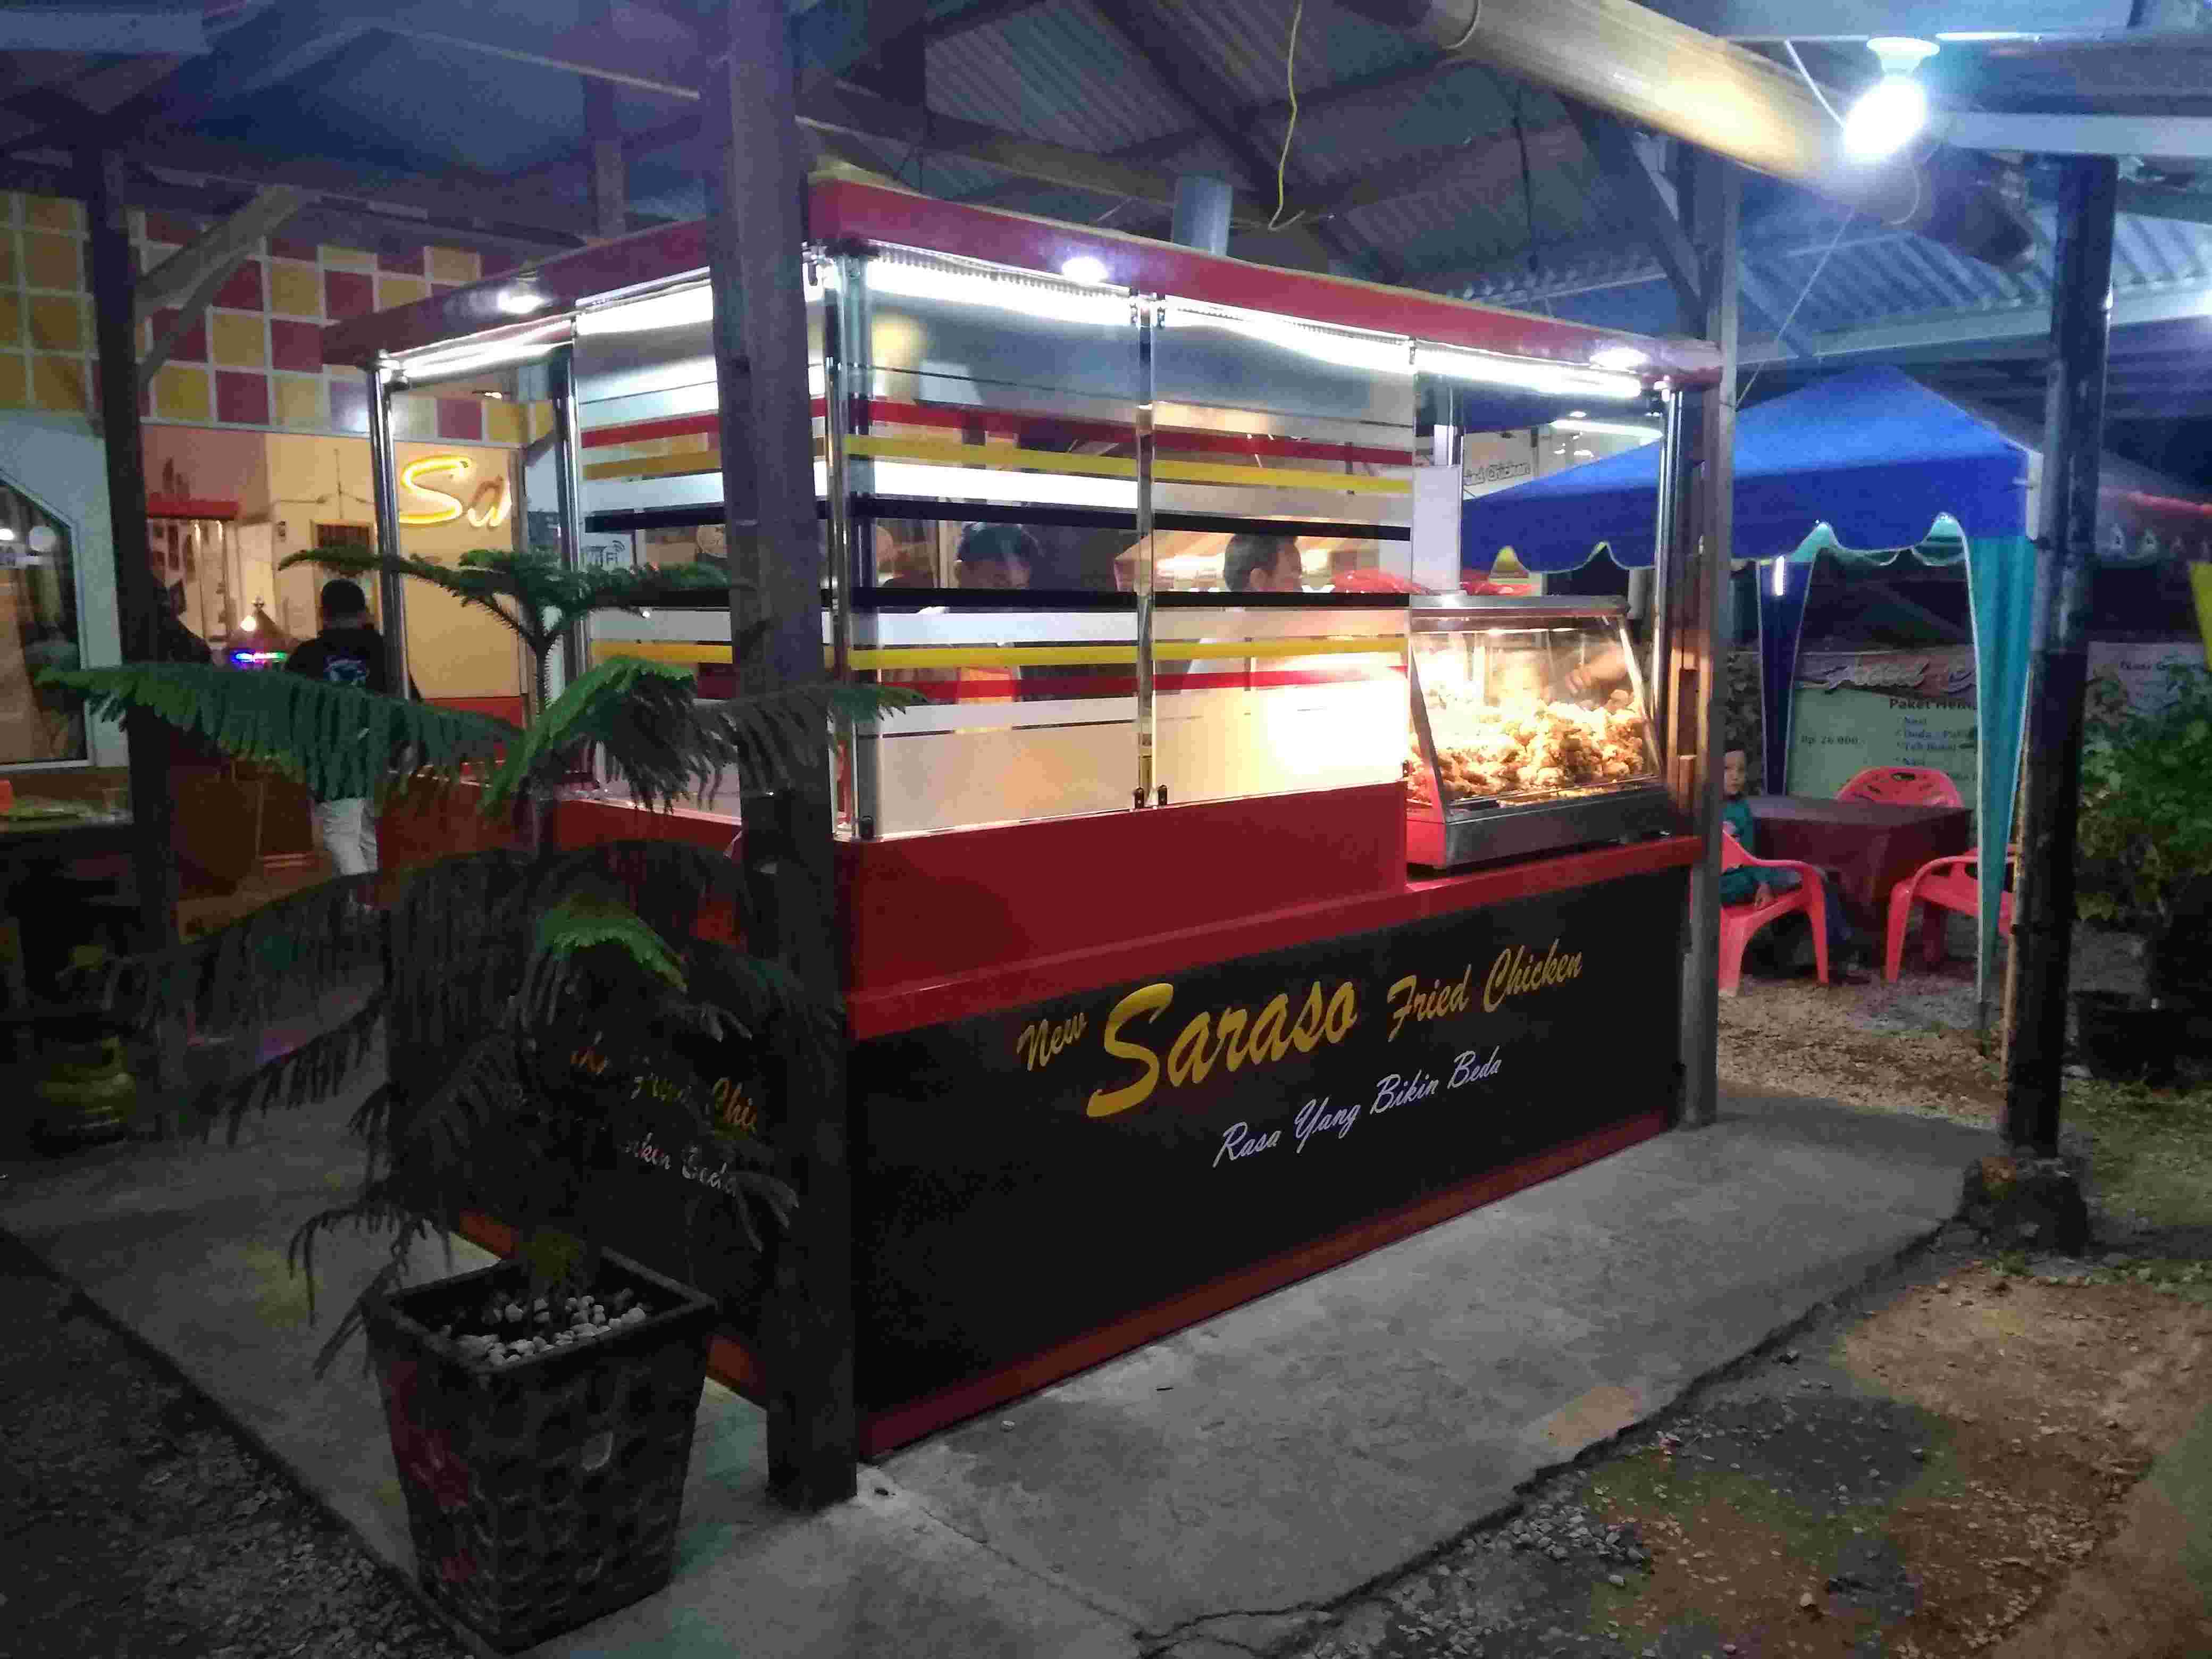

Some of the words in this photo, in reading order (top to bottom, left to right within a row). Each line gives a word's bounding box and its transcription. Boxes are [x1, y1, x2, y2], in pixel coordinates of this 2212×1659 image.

[1016, 1011, 1087, 1071] New
[1086, 983, 1358, 1117] Saraso
[1386, 963, 1471, 1043] Fried
[1483, 939, 1582, 1013] Chicken
[1212, 1121, 1282, 1168] Rasa
[1294, 1096, 1361, 1154] Yang
[1369, 1069, 1440, 1115] Bikin
[1447, 1045, 1502, 1090] Beda
